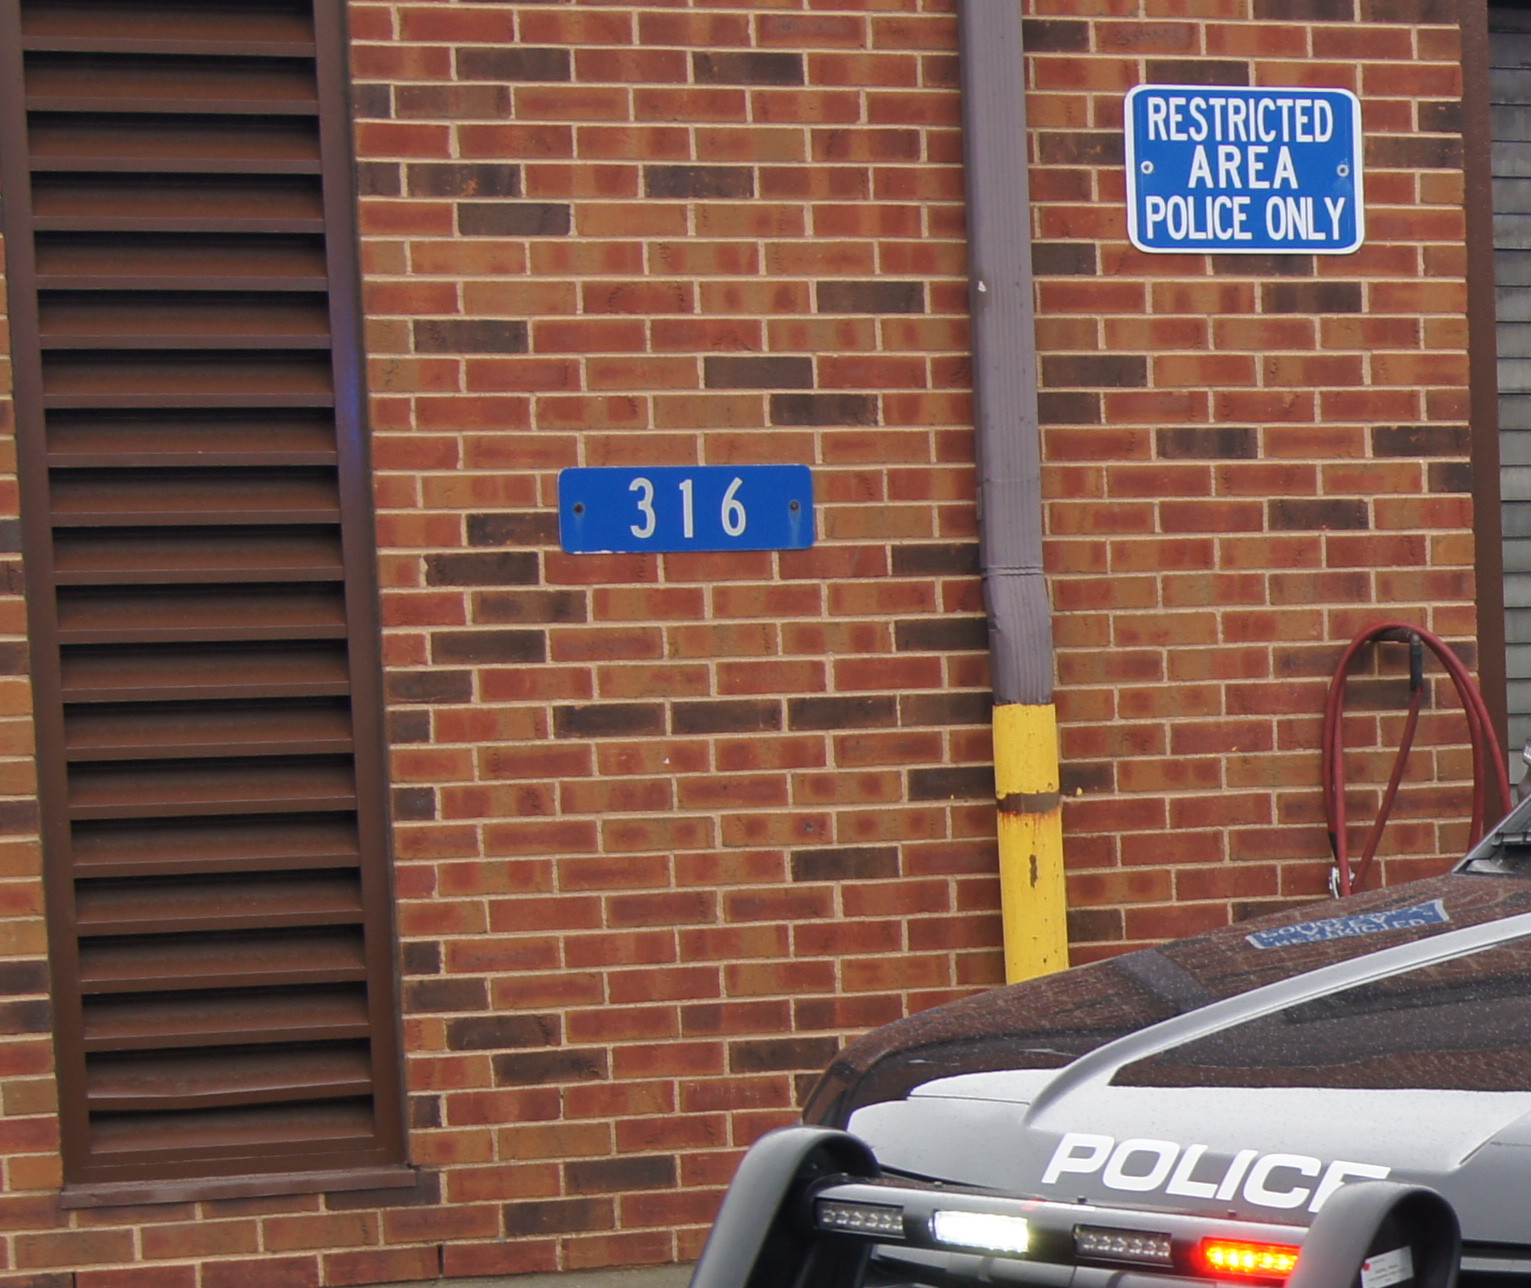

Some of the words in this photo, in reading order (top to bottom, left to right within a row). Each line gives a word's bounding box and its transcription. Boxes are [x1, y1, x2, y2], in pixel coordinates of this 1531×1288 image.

[1147, 96, 1334, 142] RESTRICTED
[1188, 145, 1299, 189] AREA
[1145, 195, 1253, 240] POLICE
[1265, 196, 1346, 241] ONLY
[629, 477, 747, 538] 316
